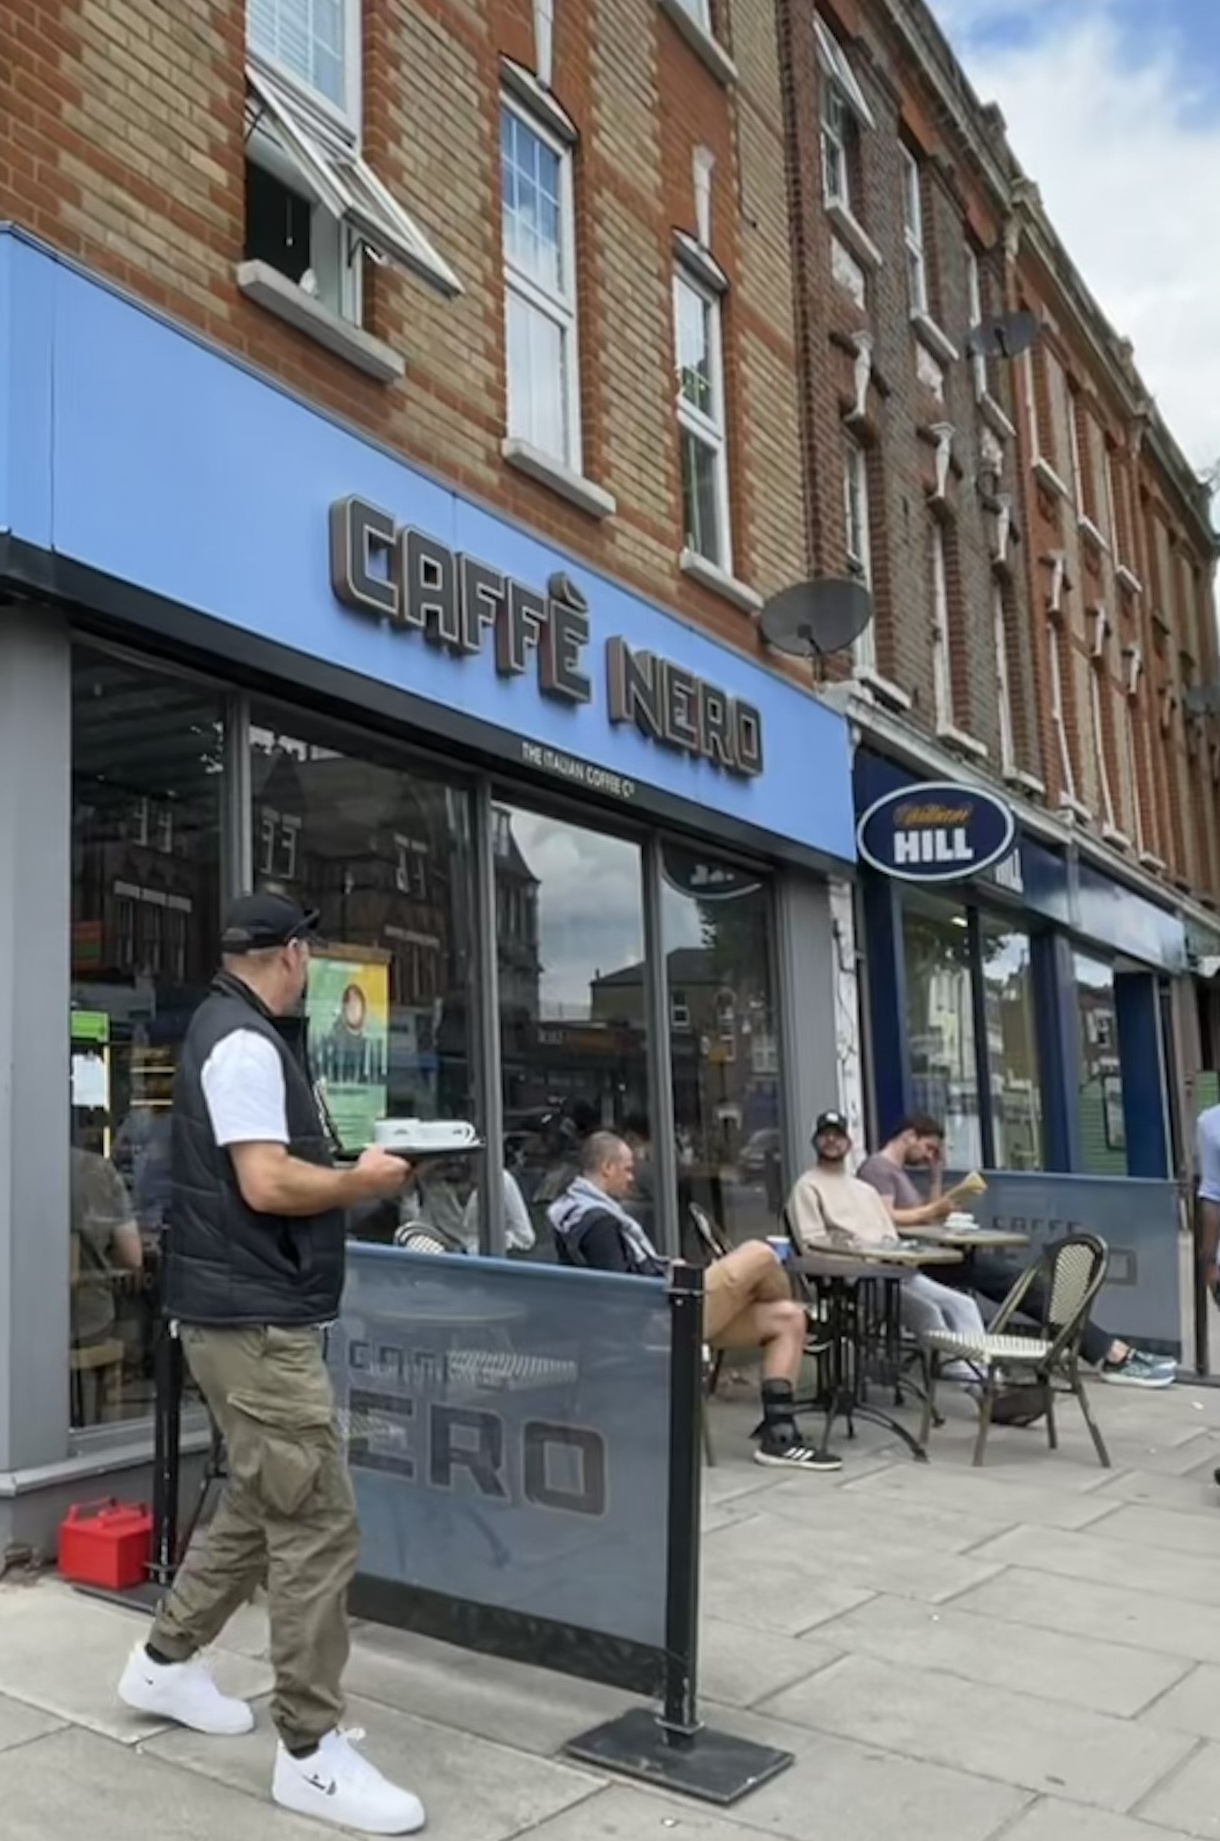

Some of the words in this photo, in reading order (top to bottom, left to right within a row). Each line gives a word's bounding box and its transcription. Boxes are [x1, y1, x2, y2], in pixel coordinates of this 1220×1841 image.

[606, 634, 764, 777] NERO
[521, 741, 542, 767] THE
[543, 750, 584, 780] ITALIAN
[585, 765, 621, 796] COFFEE
[894, 827, 974, 864] HILL
[345, 1387, 609, 1521] ERO
